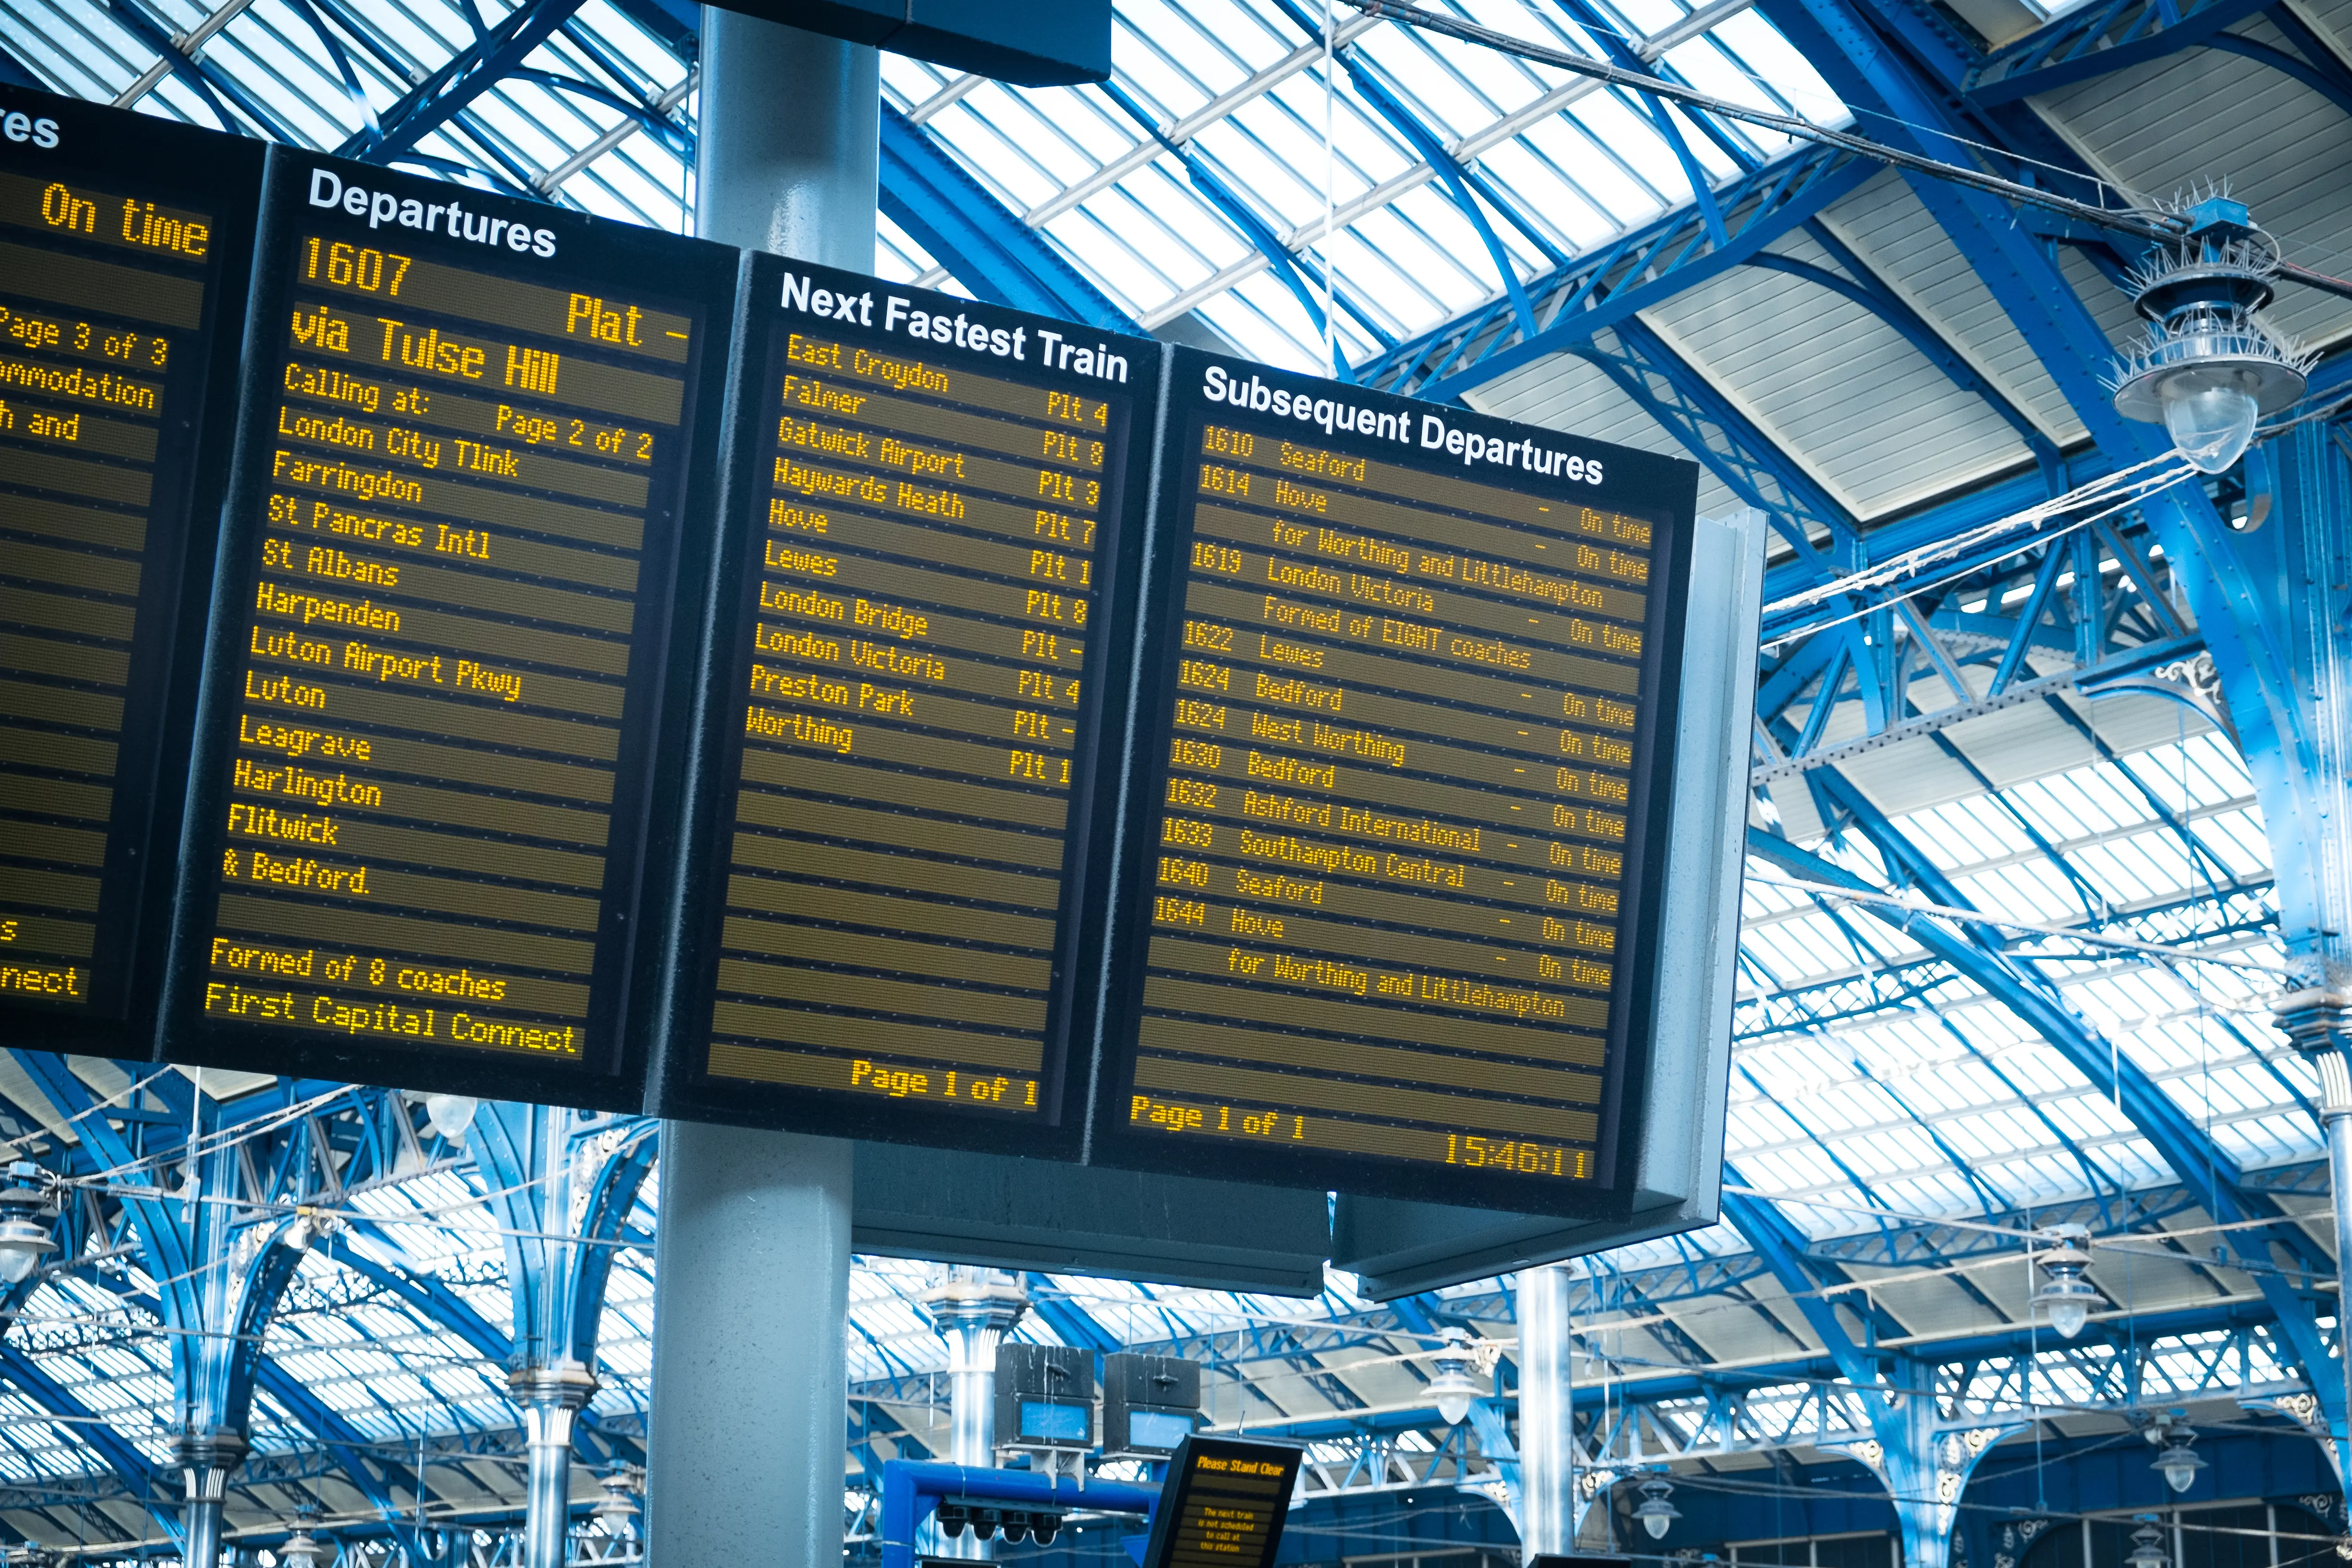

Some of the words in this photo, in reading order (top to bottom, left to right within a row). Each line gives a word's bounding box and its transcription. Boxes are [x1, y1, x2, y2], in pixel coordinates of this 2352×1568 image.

[41, 183, 96, 233] On
[122, 198, 208, 256] time
[308, 168, 556, 257] Departures
[307, 237, 412, 296] 1607
[566, 293, 643, 347] Plat
[781, 271, 874, 327] Next
[884, 295, 1027, 361] Fastest
[1037, 329, 1128, 383] Train
[74, 322, 91, 350] 3
[104, 332, 137, 359] of
[150, 338, 168, 366] 3
[291, 306, 350, 353] via
[377, 317, 486, 380] Tulse
[504, 344, 560, 395] Hill
[284, 363, 380, 413] Calling
[392, 387, 430, 416] at:
[495, 404, 558, 444] Page
[568, 418, 585, 447] 2
[595, 428, 627, 454] of
[636, 432, 653, 460] 2
[787, 333, 843, 370] East
[854, 349, 949, 393] Croydon
[1047, 391, 1083, 422] Plt
[1093, 404, 1108, 427] 4
[27, 413, 80, 441] and
[278, 405, 375, 450] London
[386, 427, 441, 469] City
[454, 439, 520, 478] Tlink
[783, 375, 867, 415] Falmer
[1043, 430, 1079, 462] Plt
[1090, 441, 1104, 466] 8
[1202, 366, 1411, 444] Subsequent
[1420, 414, 1604, 486] Departures
[272, 450, 423, 503] Farringdon
[779, 416, 871, 459] Gatwick
[880, 437, 966, 479] Airport
[1038, 470, 1075, 502] Plt
[1085, 480, 1100, 506] 3
[1205, 426, 1254, 457] 1610
[1280, 442, 1366, 482] Seaford
[1581, 508, 1603, 532] On
[1613, 518, 1650, 543] time
[268, 494, 299, 525] St
[312, 501, 424, 547] Pancras
[434, 524, 490, 560] Intl
[773, 456, 888, 503] Haywards
[897, 481, 966, 519] Heath
[1034, 510, 1071, 541] Plt
[1083, 519, 1096, 544] 7
[1201, 465, 1250, 497] 1614
[1275, 481, 1327, 513] Hove
[1578, 545, 1599, 569] On
[1609, 551, 1647, 579] time
[262, 538, 294, 569] St
[306, 546, 400, 587] Albans
[765, 539, 839, 577] Lewes
[769, 498, 829, 534] Hove
[1030, 550, 1067, 581] Plt
[1079, 560, 1090, 585] 1
[1272, 520, 1310, 547] for
[1318, 528, 1409, 575] Worthing
[1419, 555, 1455, 578] and
[1462, 558, 1603, 608] Littlehampton
[256, 581, 401, 632] Harpenden
[760, 580, 845, 621] London
[854, 598, 929, 640] Bridge
[1192, 542, 1242, 574] 1619
[1267, 557, 1341, 594] London
[1350, 574, 1434, 612] Victoria
[250, 625, 332, 665] Luton
[343, 641, 443, 684] Airport
[456, 659, 522, 703] Pkwy
[755, 622, 840, 662] London
[850, 639, 945, 681] Victoria
[1018, 670, 1055, 700] Plt
[1066, 679, 1080, 704] 4
[1185, 621, 1234, 652] 1622
[1260, 635, 1325, 669] Lewes
[1264, 595, 1341, 633] Formed
[1349, 616, 1373, 638] of
[1382, 619, 1442, 650] EIGHT
[1451, 638, 1531, 669] coaches
[245, 670, 327, 709] Luton
[750, 663, 849, 706] Preston
[858, 682, 915, 717] Park
[1181, 660, 1231, 691] 1624
[1255, 673, 1343, 711] Bedford
[239, 714, 372, 761] Leagrave
[746, 705, 854, 754] Worthing
[1009, 749, 1046, 780] Plt
[1059, 758, 1069, 784] 1
[1172, 738, 1222, 770] 1630
[1247, 750, 1336, 789] Bedford
[1176, 698, 1226, 730] 1624
[1251, 712, 1304, 744] West
[1313, 723, 1406, 768] Worthing
[233, 758, 382, 807] Harlington
[1167, 778, 1218, 809] 1632
[1243, 790, 1332, 827] Ashford
[1339, 806, 1481, 852] International
[227, 803, 339, 845] Flitwick
[1163, 817, 1213, 847] 1633
[1239, 829, 1377, 874] Southampton
[1385, 853, 1465, 888] Central
[222, 848, 239, 877] &
[251, 851, 370, 894] Bedford.
[1159, 857, 1210, 887] 1640
[1236, 869, 1323, 905] Seaford
[1155, 896, 1206, 926] 1644
[1231, 908, 1285, 938] Hove
[210, 937, 314, 977] Formed
[325, 955, 358, 981] of
[368, 958, 386, 986] 8
[397, 968, 507, 1001] coaches
[1227, 947, 1265, 975] for
[1274, 955, 1368, 996] Worthing
[1376, 973, 1414, 996] and
[1421, 975, 1565, 1018] Littlehampton
[205, 982, 295, 1020] First
[312, 995, 435, 1037] Capital
[451, 1013, 576, 1053] Connect
[851, 1059, 929, 1098] Page
[943, 1071, 957, 1097] 1
[970, 1077, 1010, 1102] of
[1024, 1080, 1037, 1106] 1
[1130, 1095, 1203, 1132] Page
[1217, 1106, 1230, 1131] 1
[1242, 1111, 1279, 1136] of
[1292, 1115, 1304, 1139] 1
[1445, 1134, 1585, 1178] 15:46:11
[1197, 1456, 1228, 1470] Please
[1230, 1459, 1259, 1474] Stand
[1260, 1462, 1284, 1476] Clear
[1204, 1507, 1216, 1517] The
[1217, 1510, 1234, 1519] next
